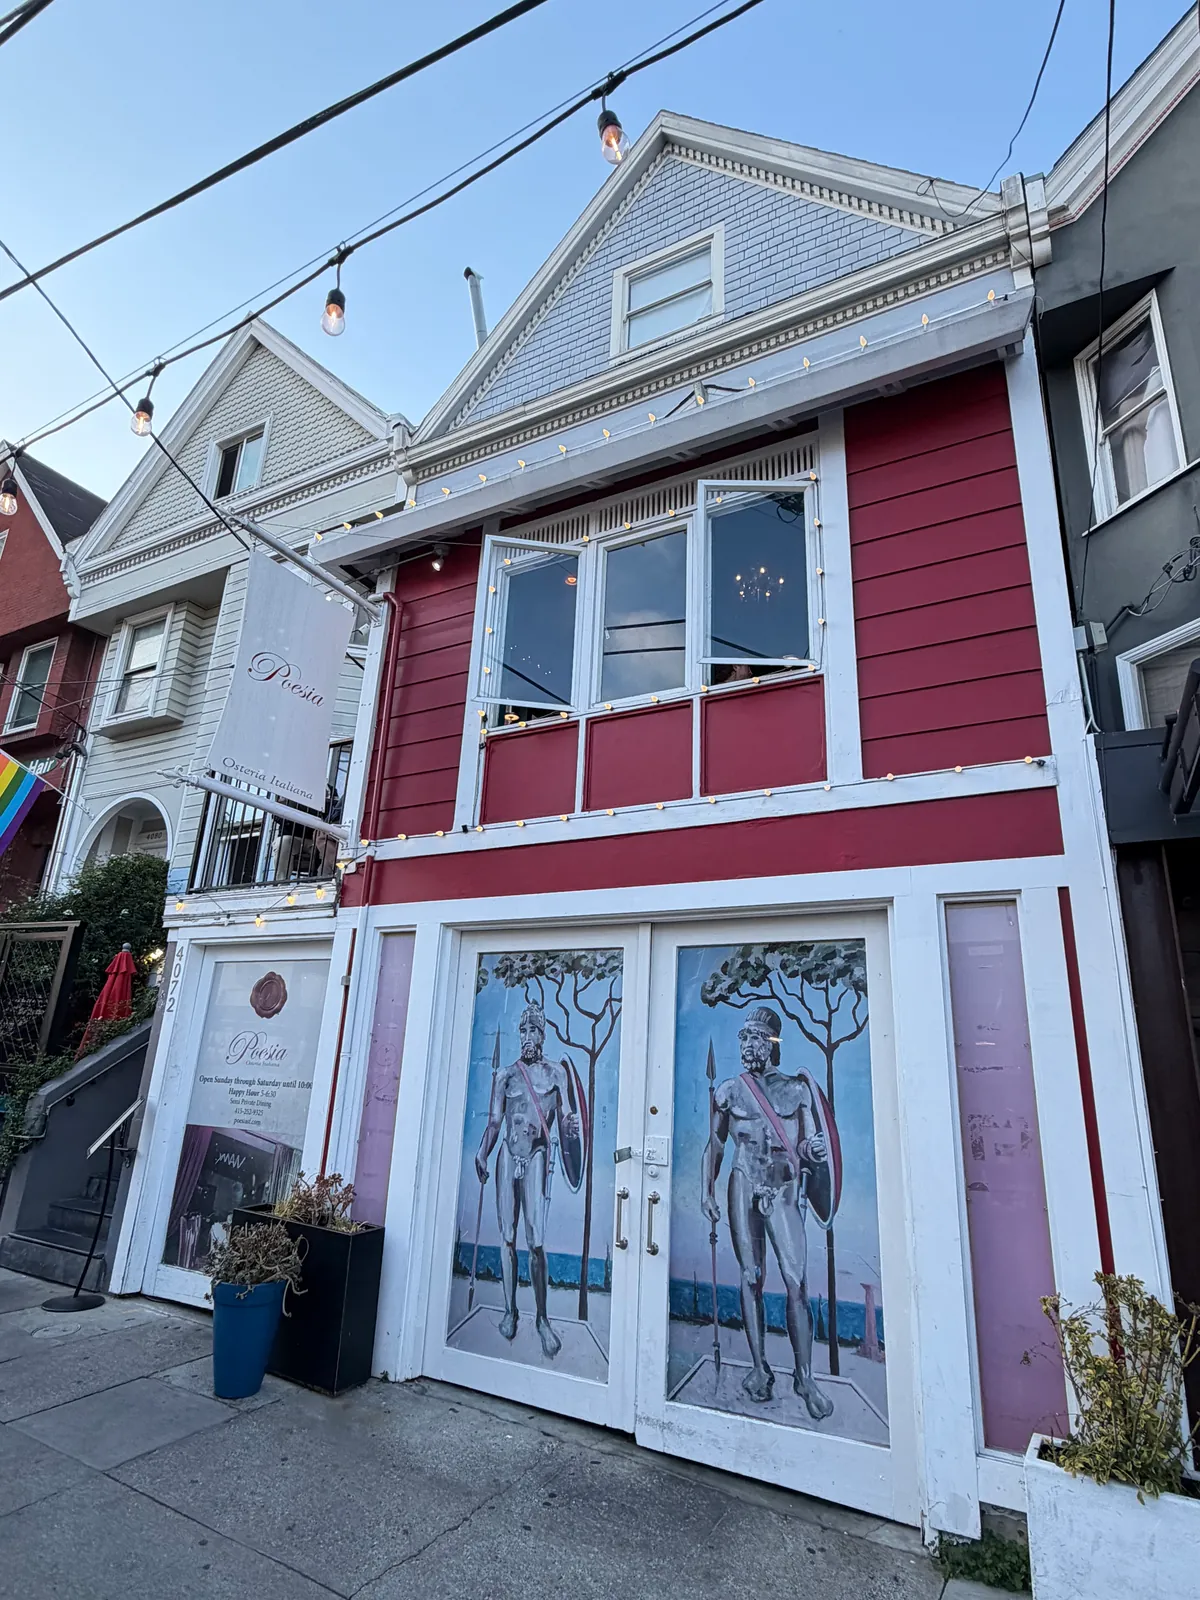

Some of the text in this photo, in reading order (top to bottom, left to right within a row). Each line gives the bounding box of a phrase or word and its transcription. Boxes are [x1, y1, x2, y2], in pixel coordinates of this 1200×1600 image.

[247, 652, 325, 707] Poesia
[29, 757, 56, 775] Hair
[222, 757, 314, 800] Osteria Italiana
[166, 945, 184, 1013] 4072
[226, 1030, 288, 1065] Poesia
[199, 1074, 214, 1084] Open
[214, 1075, 233, 1086] Sunday
[234, 1077, 256, 1087] through
[257, 1078, 281, 1089] Saturday
[283, 1080, 297, 1088] until
[228, 1087, 277, 1098] Happy Hour 5-6:30
[230, 1097, 272, 1109] Semi Private Dining
